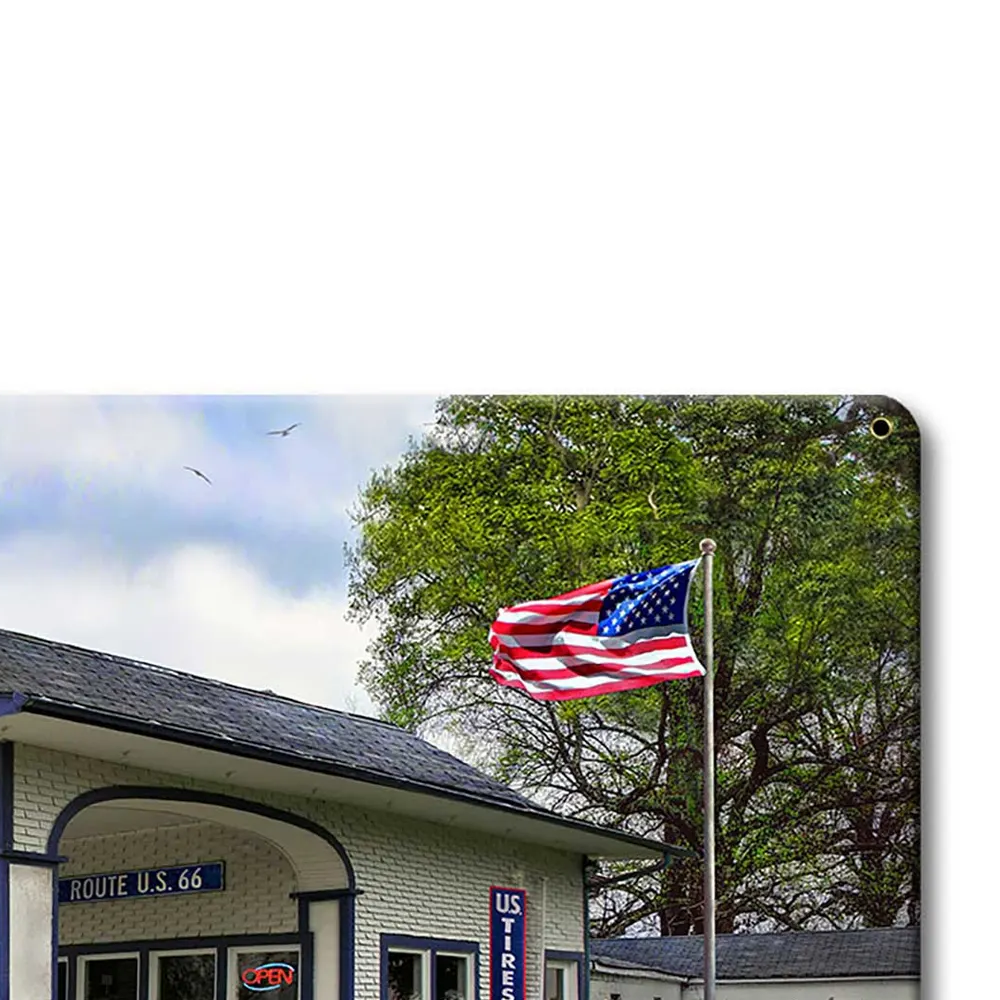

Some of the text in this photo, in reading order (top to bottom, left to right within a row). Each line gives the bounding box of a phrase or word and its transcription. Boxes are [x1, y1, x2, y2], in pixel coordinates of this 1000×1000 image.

[70, 867, 203, 901] ROUTE U.S. 66
[495, 892, 523, 916] U.S.
[241, 967, 295, 986] OPEN
